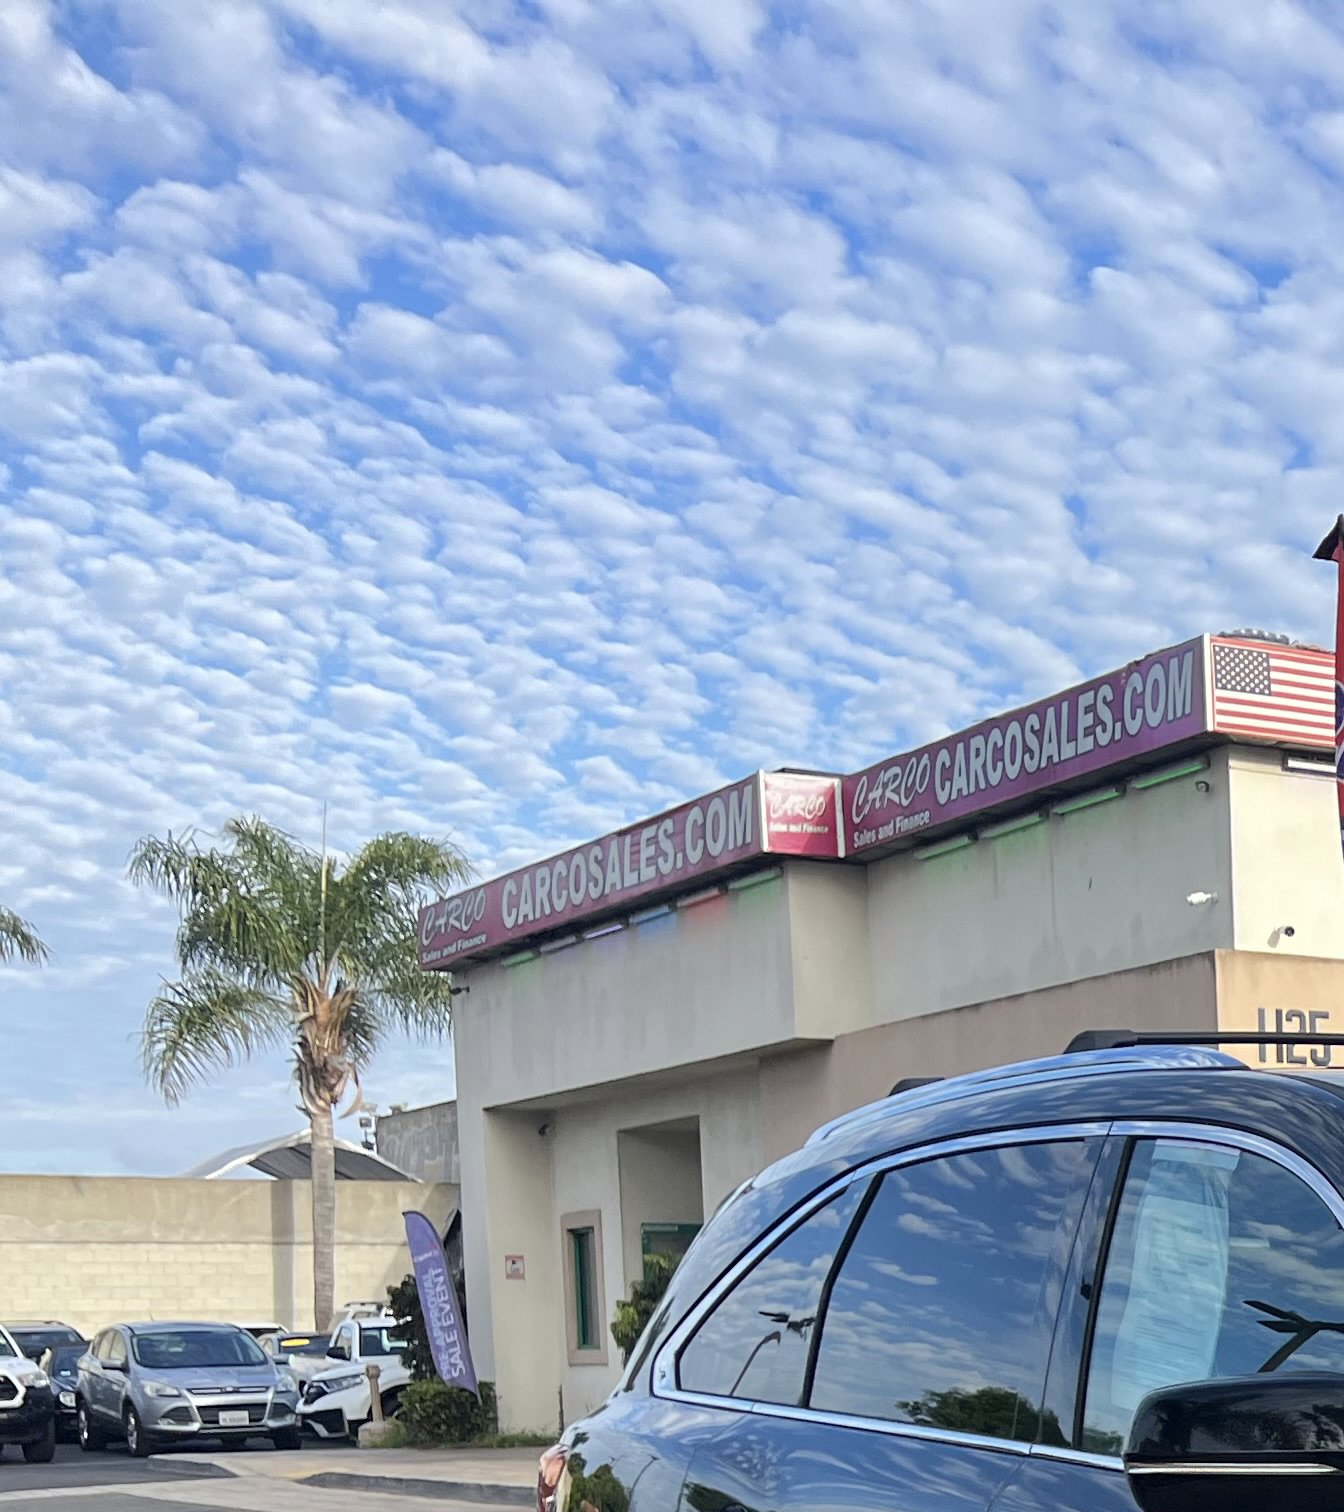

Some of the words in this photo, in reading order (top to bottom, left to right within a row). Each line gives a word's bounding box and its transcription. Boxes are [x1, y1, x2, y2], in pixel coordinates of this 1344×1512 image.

[852, 753, 931, 825] CARCO
[934, 650, 1194, 806] CARCOSALES.COM
[854, 829, 876, 848] Sales
[878, 820, 894, 839] and
[896, 810, 930, 833] Finance
[422, 887, 486, 948] CARCO
[501, 784, 753, 930] CARCOSALES.COM
[1257, 1007, 1331, 1067] 1125
[431, 1266, 455, 1329] EVENT
[445, 1329, 466, 1378] SALE
